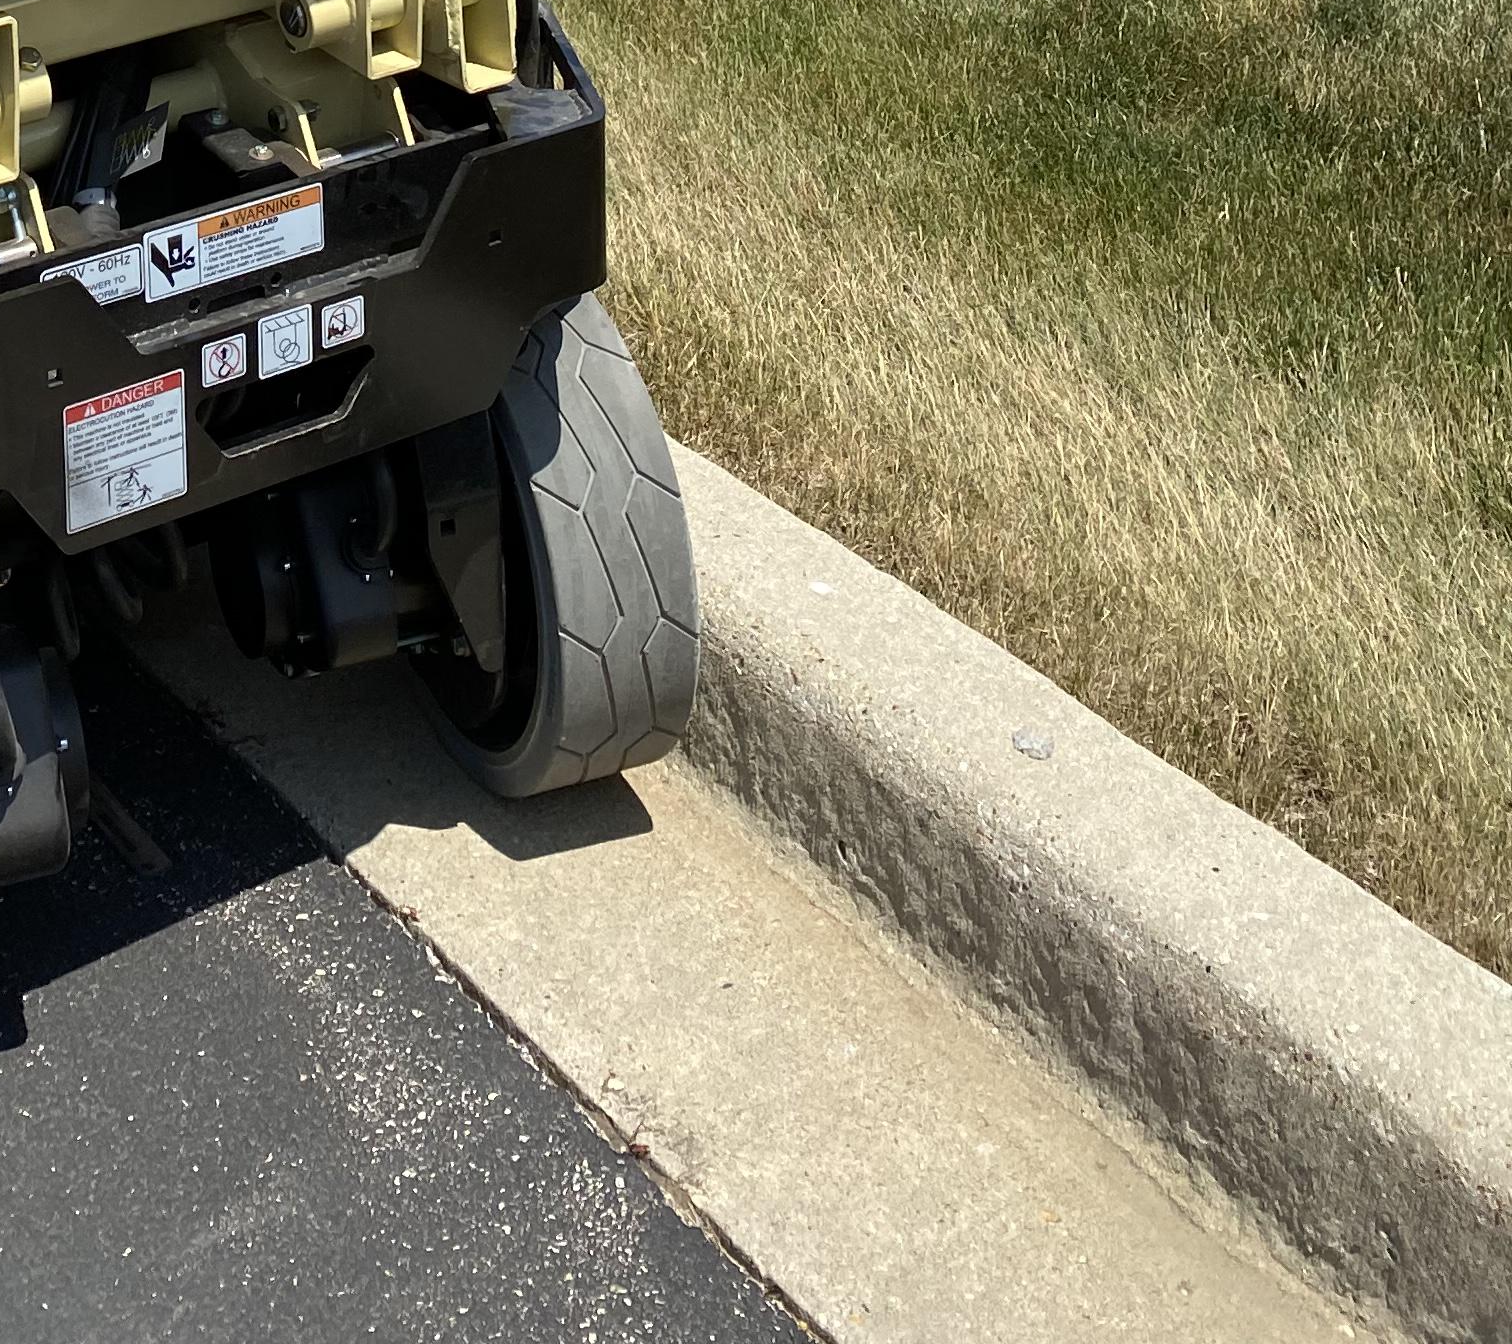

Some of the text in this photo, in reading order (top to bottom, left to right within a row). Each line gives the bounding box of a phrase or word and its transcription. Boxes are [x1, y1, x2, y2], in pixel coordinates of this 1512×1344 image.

[234, 193, 300, 224] WARNING
[202, 215, 278, 245] CRUSHING HAZARD
[98, 255, 130, 272] 60Hz
[113, 275, 126, 285] TO
[101, 379, 163, 411] DANGER
[68, 409, 125, 433] ELECTROCUTION
[126, 399, 154, 413] HAZARD
